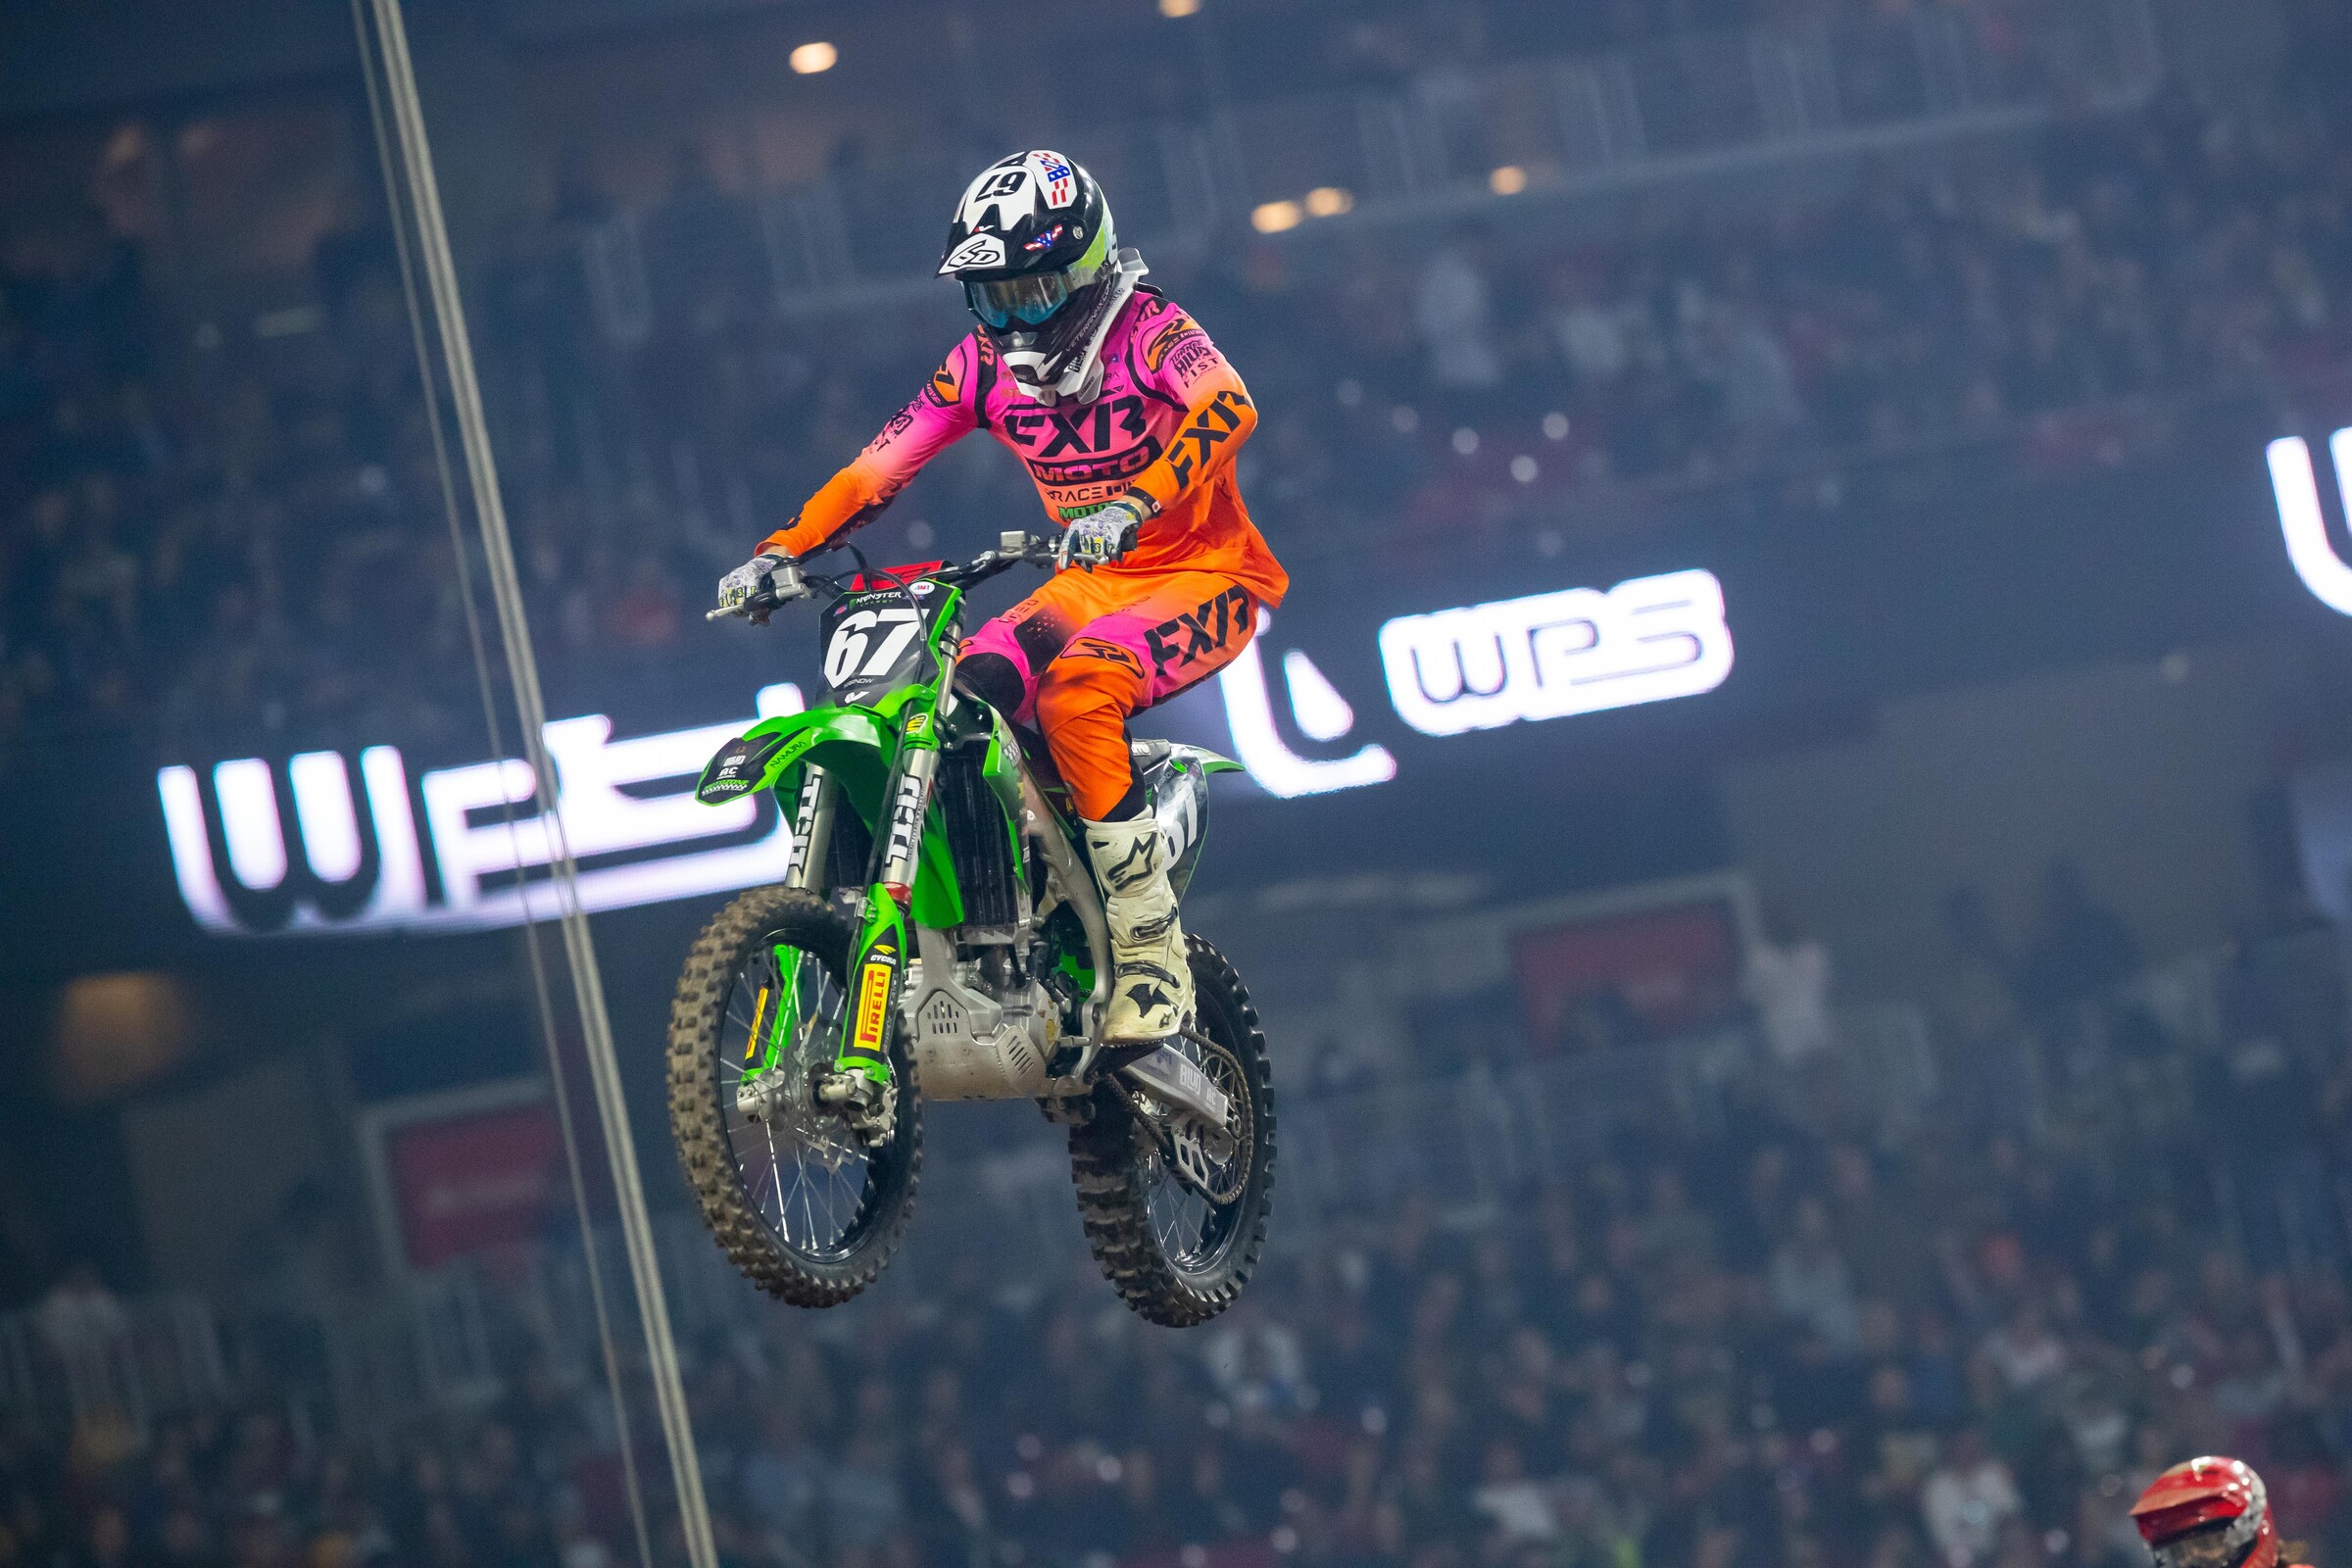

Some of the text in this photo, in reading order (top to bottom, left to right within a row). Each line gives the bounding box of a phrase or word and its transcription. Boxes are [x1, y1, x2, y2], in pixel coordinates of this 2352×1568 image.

[1004, 395, 1147, 458] FXR
[1033, 443, 1151, 481] MOTO
[1166, 391, 1251, 490] FXR
[856, 591, 902, 604] MONSTER
[1144, 585, 1249, 676] FXR
[824, 608, 930, 689] 67
[1399, 590, 1712, 713] WPS
[859, 969, 886, 1044] PIRELLI
